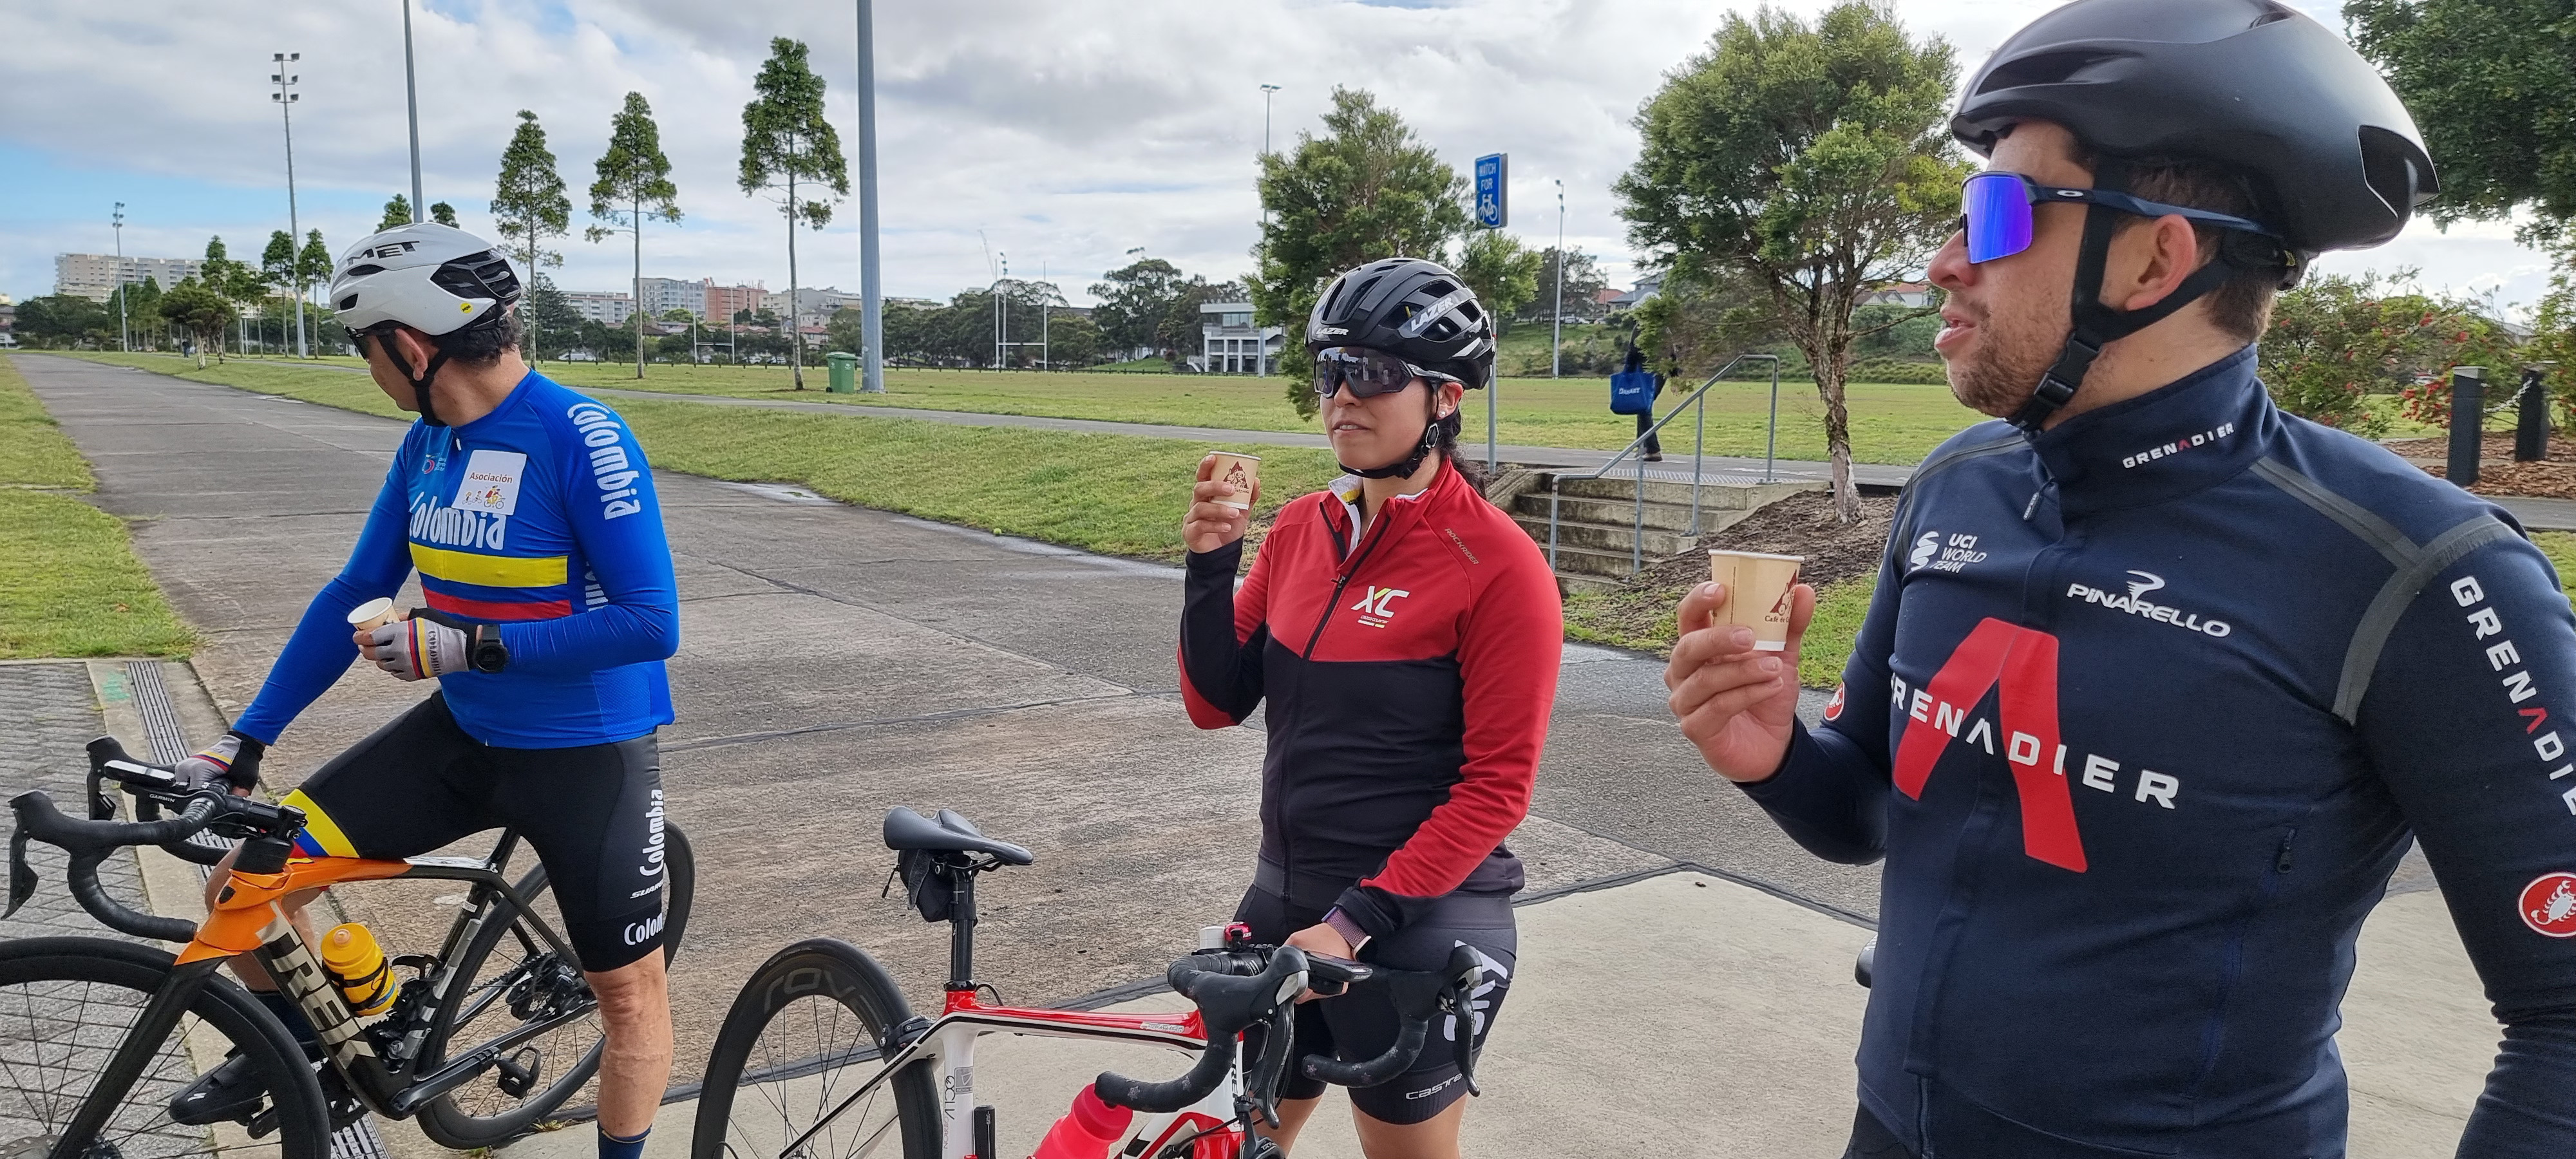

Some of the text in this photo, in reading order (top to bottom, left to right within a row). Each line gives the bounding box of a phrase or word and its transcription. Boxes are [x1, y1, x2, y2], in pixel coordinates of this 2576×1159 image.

[1479, 163, 1496, 176] WATCH
[1481, 178, 1493, 191] FOR
[347, 241, 420, 266] MET
[1316, 327, 1349, 335] LAZER
[1410, 297, 1454, 332] LAZER
[567, 402, 641, 520] Colombia
[2123, 422, 2235, 468] GRENADIER
[469, 472, 513, 483] Asociación
[1444, 528, 1479, 564] ROCKRIDER
[1941, 547, 1987, 563] WORLD
[1949, 533, 1978, 549] UCI
[1929, 560, 1966, 574] TEAM
[1350, 585, 1410, 618] XC
[2067, 583, 2231, 637] PINARELLO
[1891, 673, 2180, 809] RENADIER
[149, 794, 175, 802] GARMIN
[639, 789, 665, 876] Colombia
[256, 900, 377, 1070] TREK
[945, 1075, 956, 1120] OCLV
